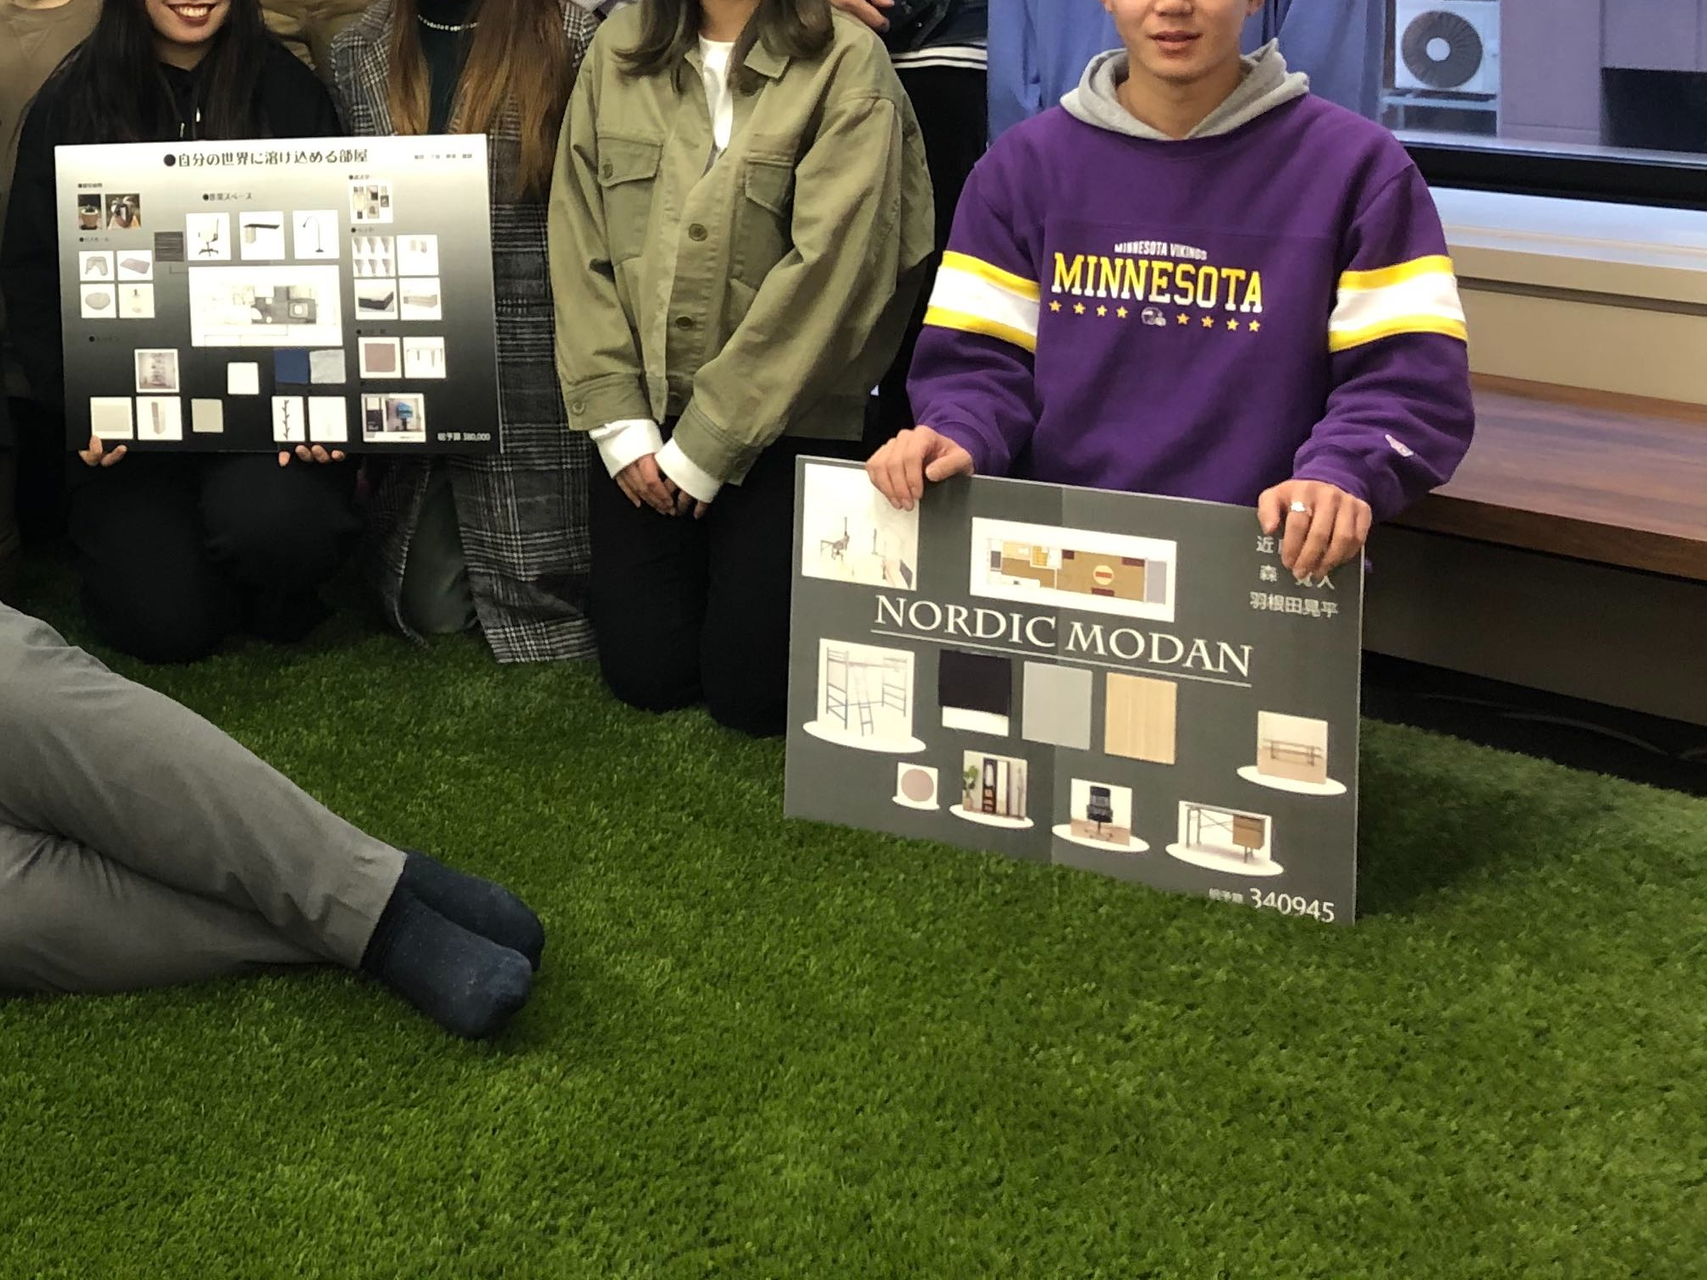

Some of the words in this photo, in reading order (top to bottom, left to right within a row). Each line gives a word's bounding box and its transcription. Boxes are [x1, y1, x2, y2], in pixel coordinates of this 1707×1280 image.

[1114, 240, 1168, 256] MINNESOTA
[1170, 243, 1208, 260] VIKINGS
[1051, 252, 1263, 313] MINNESOTA
[874, 594, 1056, 648] NORDIC
[1064, 621, 1253, 677] MODAN
[1249, 887, 1335, 923] 340945
